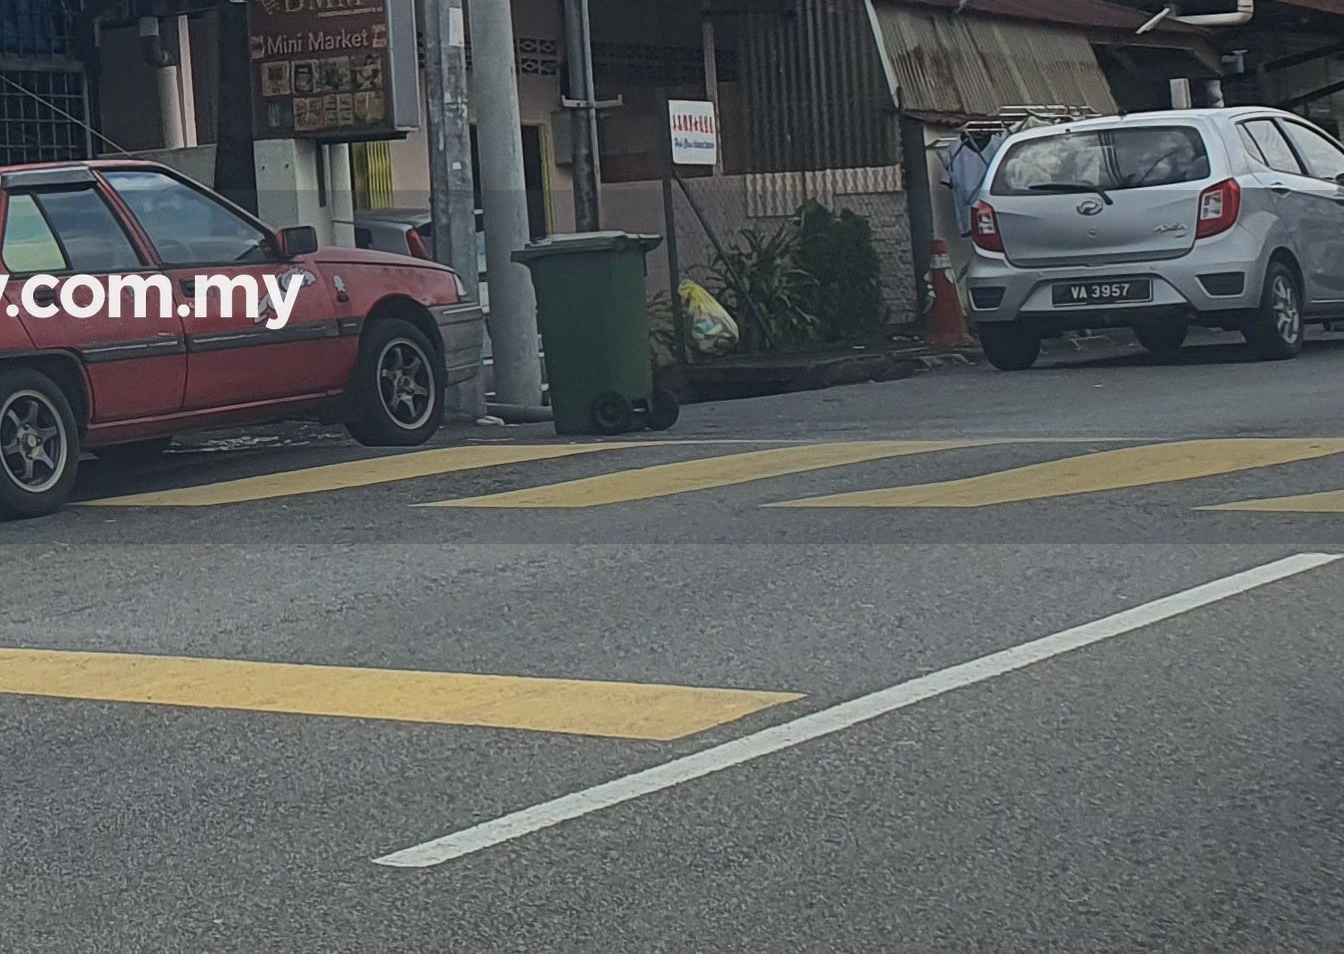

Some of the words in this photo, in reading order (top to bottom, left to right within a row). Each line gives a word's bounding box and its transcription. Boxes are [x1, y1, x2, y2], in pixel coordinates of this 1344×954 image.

[267, 32, 302, 55] Mini
[308, 28, 368, 52] Market
[1071, 286, 1088, 299] VA
[1092, 283, 1130, 298] 3957
